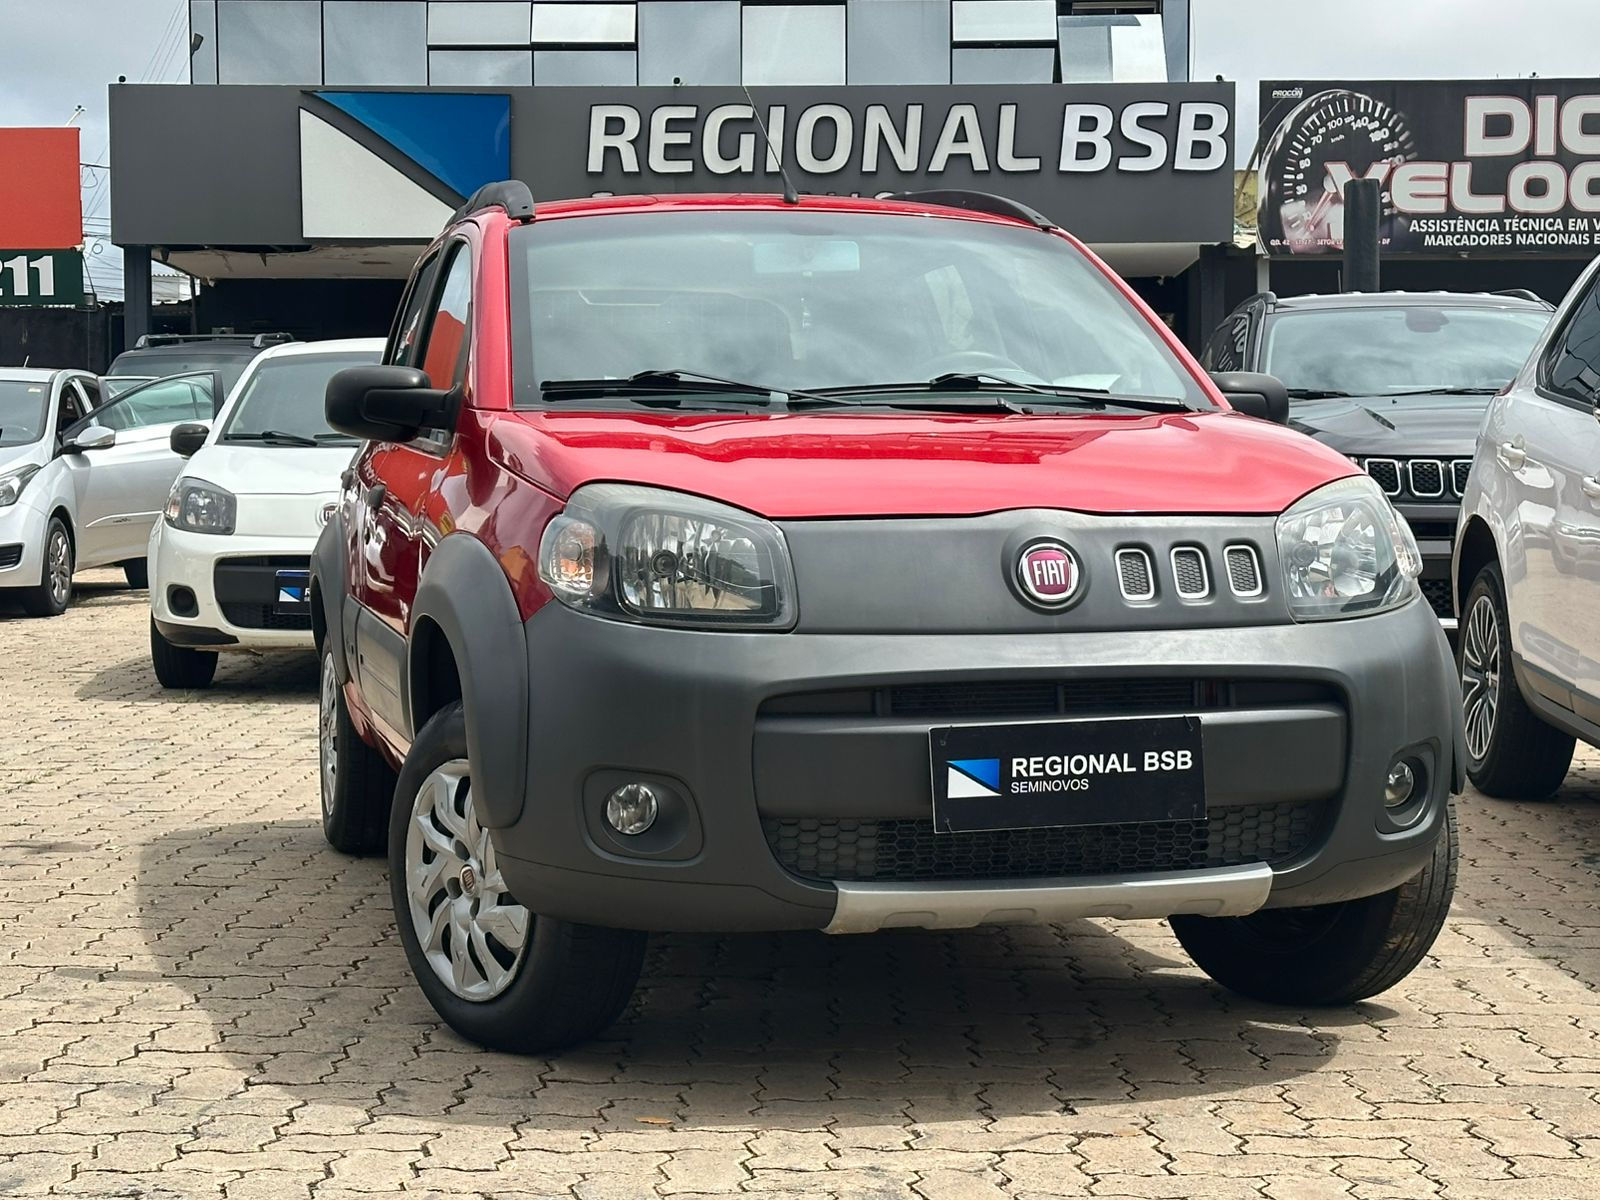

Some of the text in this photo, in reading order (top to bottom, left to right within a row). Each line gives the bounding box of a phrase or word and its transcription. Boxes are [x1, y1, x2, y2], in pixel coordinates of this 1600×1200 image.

[1327, 117, 1343, 130] 100
[1350, 116, 1369, 130] 140
[587, 102, 1229, 174] REGIONAL BSB
[1310, 134, 1322, 146] 70
[1409, 216, 1500, 232] ASSISTÊNCIA
[1504, 215, 1564, 231] TÉCNICA
[1568, 218, 1588, 231] EM
[1424, 234, 1512, 246] MARCADORES
[1516, 233, 1590, 245] NACIONAIS
[0, 255, 55, 296] 11
[1032, 559, 1066, 586] FIAT
[1012, 750, 1193, 778] REGIONAL BSB
[1011, 778, 1089, 794] SEMINOVOS
